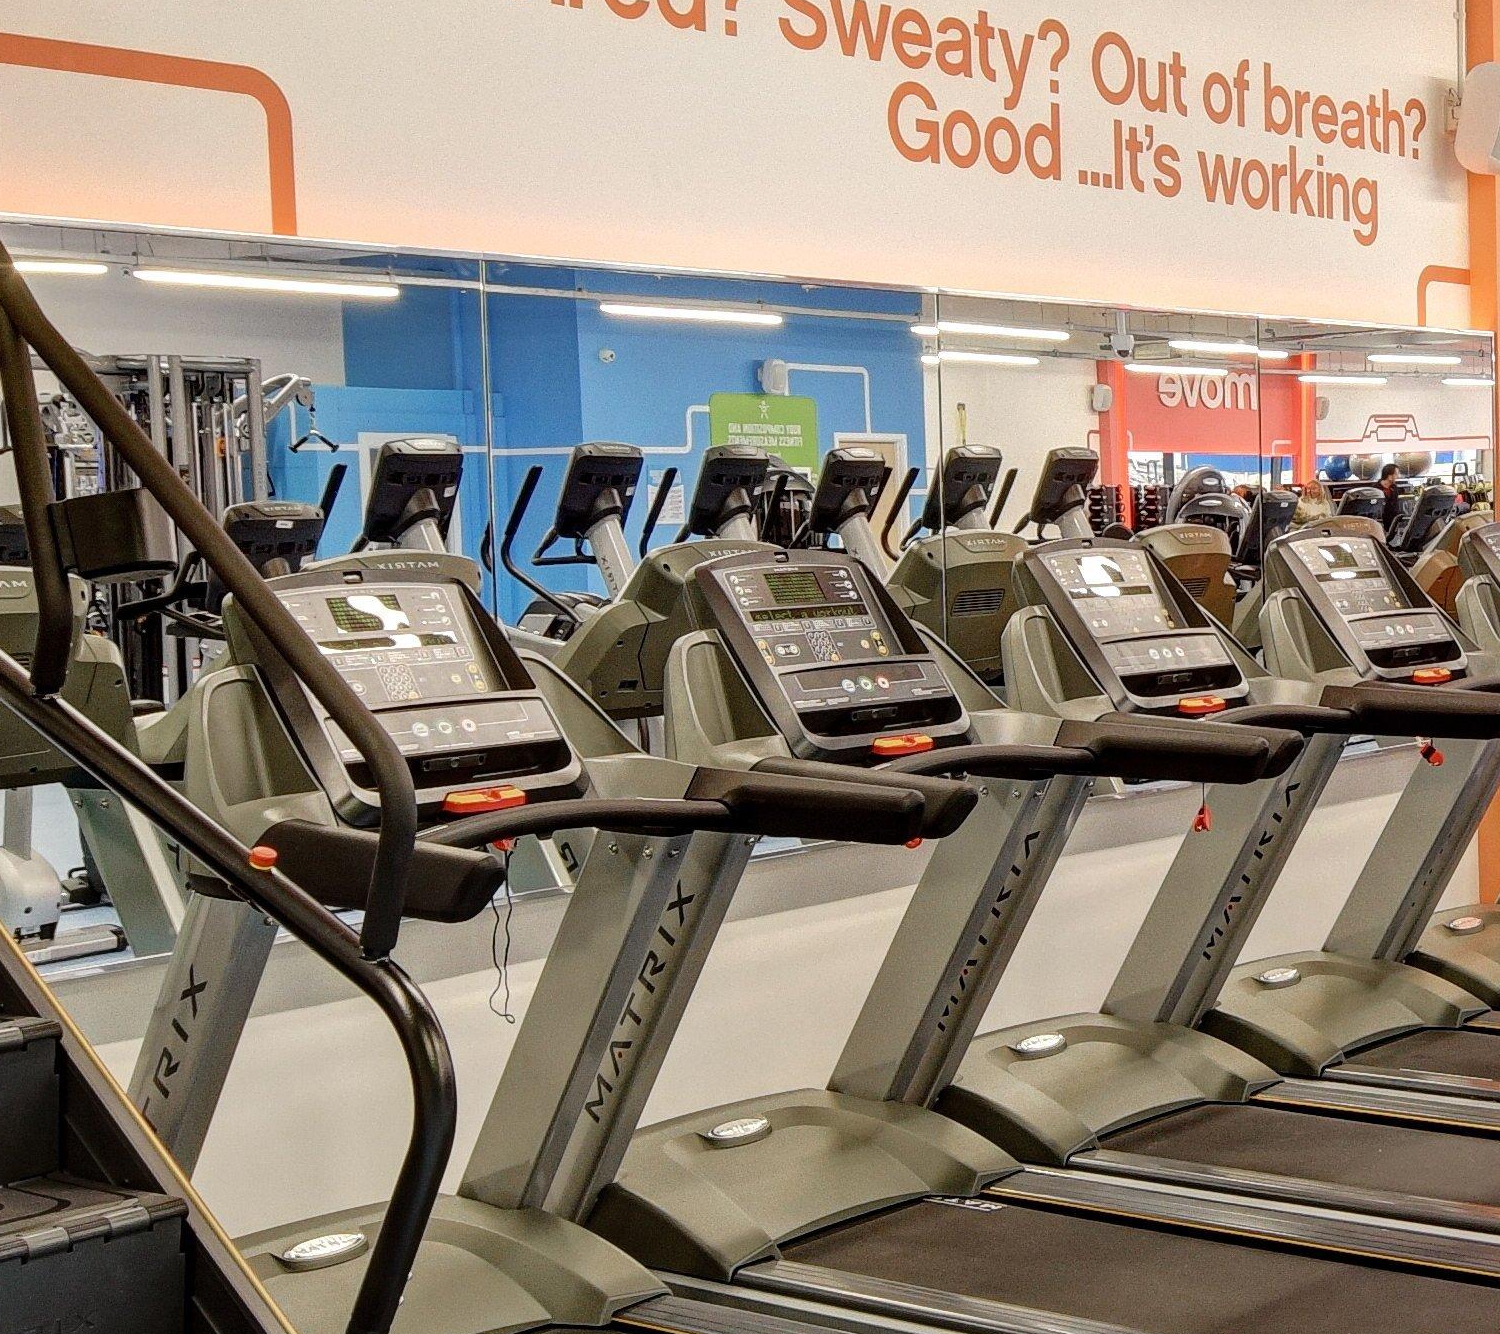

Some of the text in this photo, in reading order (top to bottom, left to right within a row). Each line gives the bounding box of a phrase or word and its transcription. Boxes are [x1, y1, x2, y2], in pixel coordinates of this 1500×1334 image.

[887, 80, 1062, 182] Good
[1196, 145, 1379, 247] working
[1091, 30, 1188, 118] Out
[1201, 58, 1251, 128] of
[1263, 61, 1428, 160] breath?
[584, 878, 696, 1125] MATRIX
